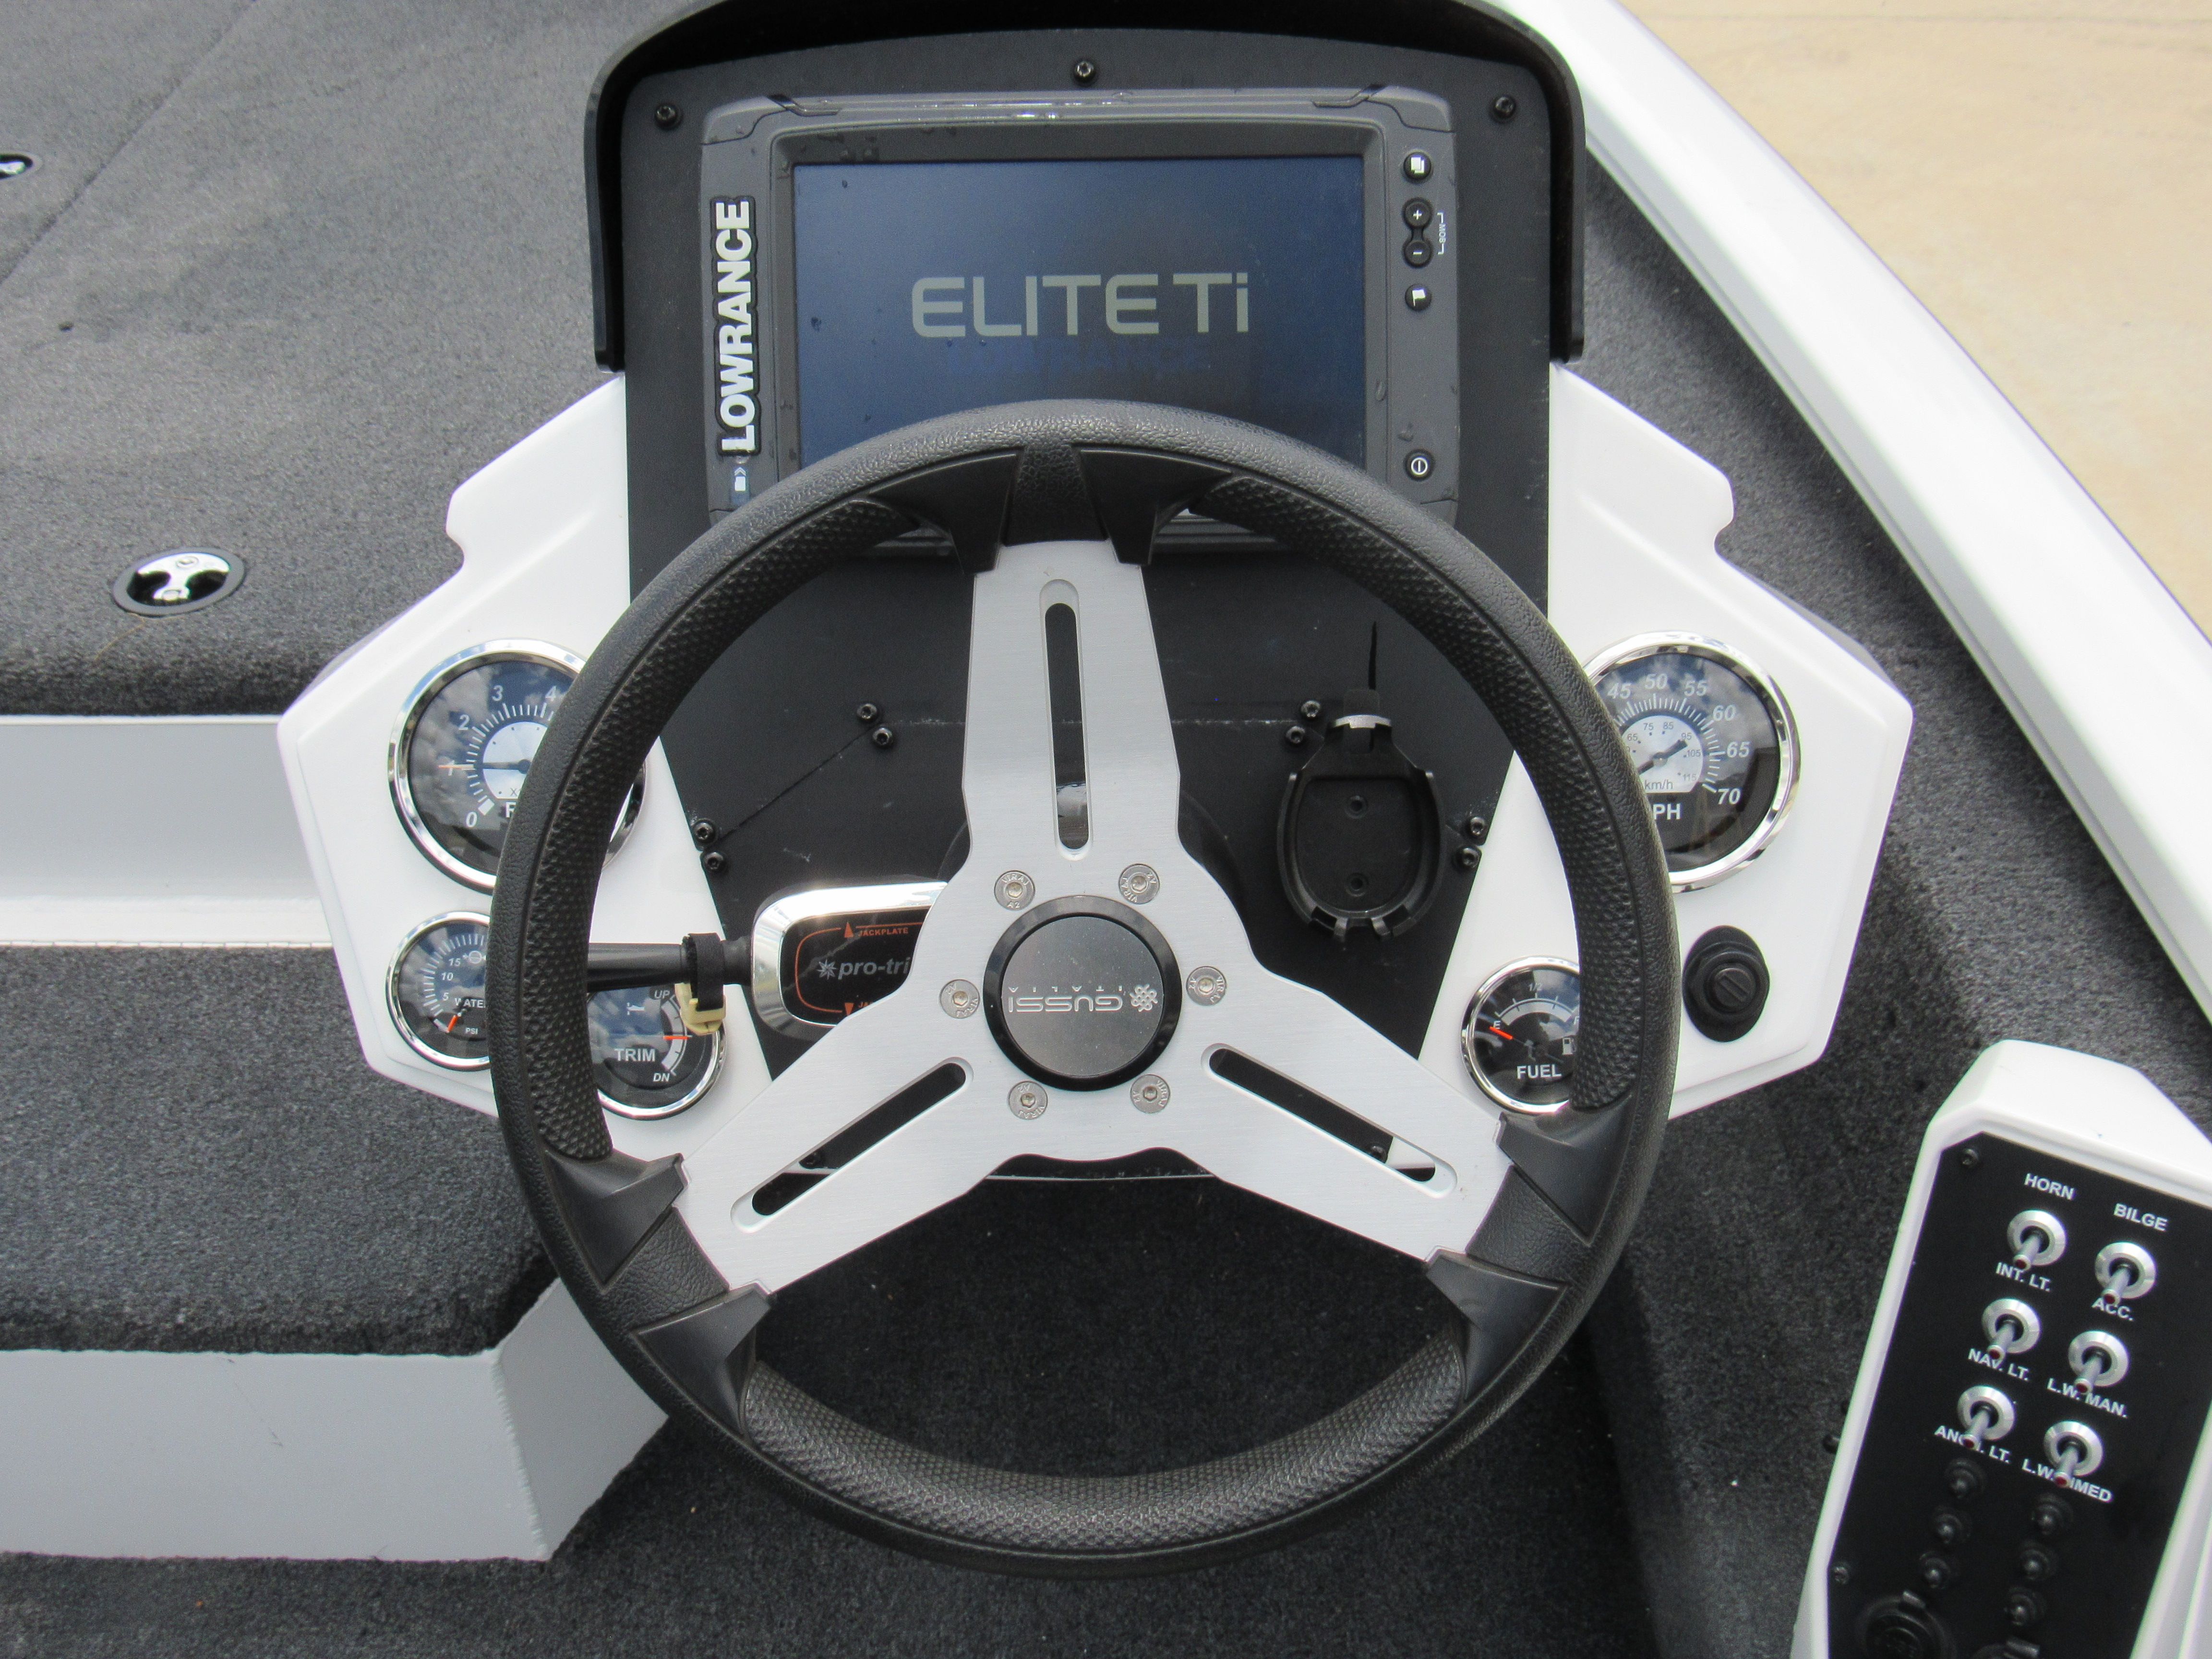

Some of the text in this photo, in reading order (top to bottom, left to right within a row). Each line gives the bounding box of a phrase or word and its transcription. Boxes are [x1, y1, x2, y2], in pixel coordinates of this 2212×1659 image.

[912, 272, 1249, 337] ELITE Ti
[715, 201, 757, 452] LOWRANCE
[1645, 673, 1668, 689] 50
[1684, 680, 1708, 697] 55
[492, 685, 503, 701] 3
[545, 685, 556, 702] 4
[1608, 682, 1632, 699] 45
[1713, 704, 1737, 721] 60
[458, 714, 470, 730] 2
[1643, 722, 1654, 731] 75
[1663, 721, 1674, 730] 85
[1627, 733, 1638, 741] 65
[1726, 741, 1750, 758] 65
[1645, 779, 1673, 790] km/h
[1718, 788, 1741, 805] 70
[466, 811, 478, 828] 0
[1653, 803, 1681, 820] PH
[858, 927, 909, 937] JACKPLATE
[448, 958, 461, 967] 15
[838, 957, 911, 980] pro-tri
[441, 972, 454, 981] 10
[442, 992, 449, 1001] 5
[455, 998, 486, 1008] WATE
[654, 990, 670, 999] UP
[1008, 995, 1123, 1012] GUSSI
[1493, 1021, 1502, 1030] E
[614, 1048, 656, 1062] TRIM
[653, 1073, 670, 1082] DN
[1516, 1064, 1562, 1080] FUEL
[2024, 1173, 2075, 1200] HORN
[2113, 1202, 2168, 1232] BILGE
[1996, 1262, 2051, 1292] INT. LT.
[2091, 1298, 2134, 1322] ACC.
[1968, 1348, 2029, 1382] NAV. LT.
[2046, 1378, 2128, 1419] L.W. MAN.
[1989, 1445, 2010, 1464] LT.
[2021, 1458, 2113, 1503] L.W. IMED
